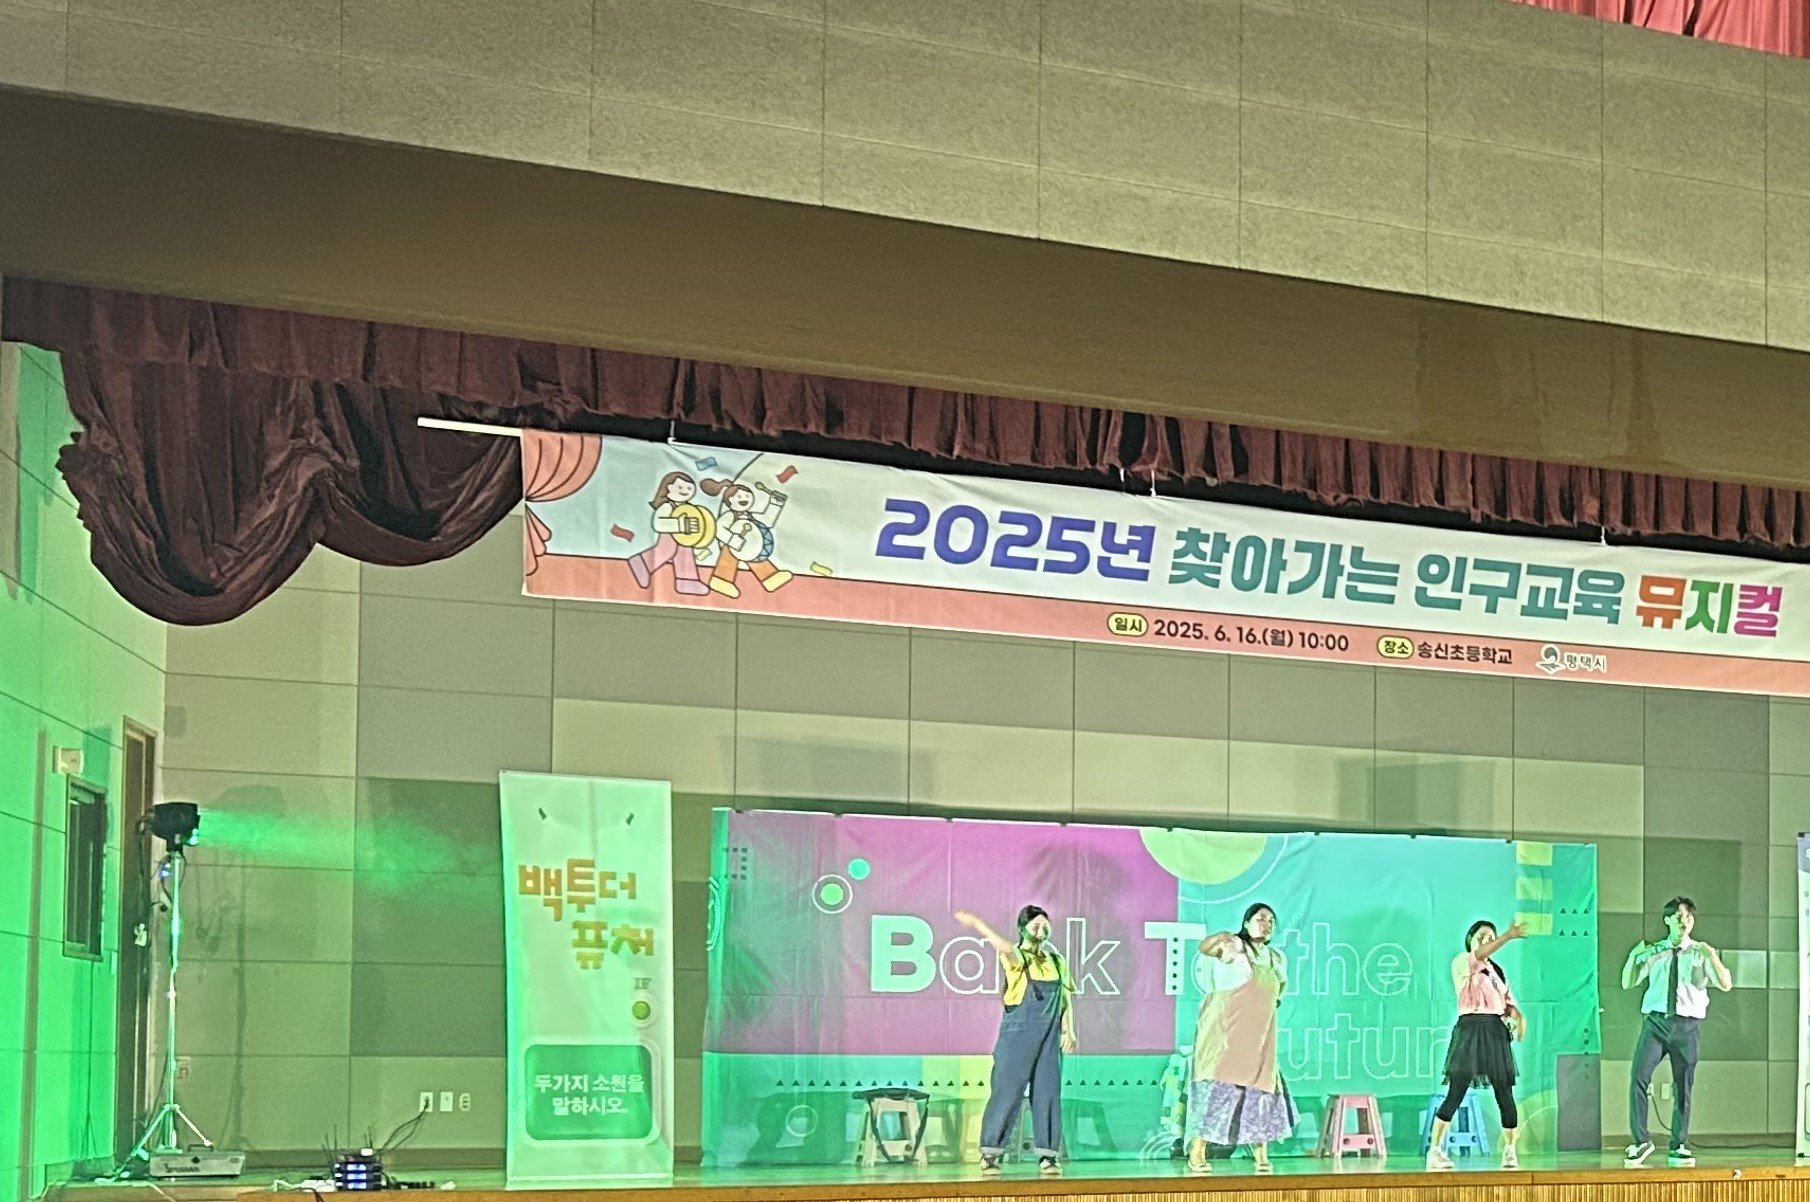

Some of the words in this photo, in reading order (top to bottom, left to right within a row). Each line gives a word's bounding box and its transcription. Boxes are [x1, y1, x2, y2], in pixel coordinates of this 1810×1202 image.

[874, 498, 1155, 583] 2025년
[1169, 526, 1402, 606] 찾아가는
[1413, 550, 1627, 627] 인구교육
[1636, 574, 1783, 639] 뮤지컬
[1114, 616, 1143, 633] 일시
[1153, 618, 1210, 641] 2025.
[1213, 624, 1232, 643] 6.
[1298, 631, 1350, 652] 10:00
[1383, 639, 1411, 655] 장소
[1416, 641, 1513, 665] 송신초등학교
[1565, 653, 1608, 672] 평택시
[517, 858, 637, 922] 백투더
[869, 913, 1122, 996] Bak
[1275, 921, 1415, 997] the
[1277, 1012, 1452, 1081] utur
[533, 1073, 589, 1094] 두가지
[591, 1073, 645, 1094] 소원을
